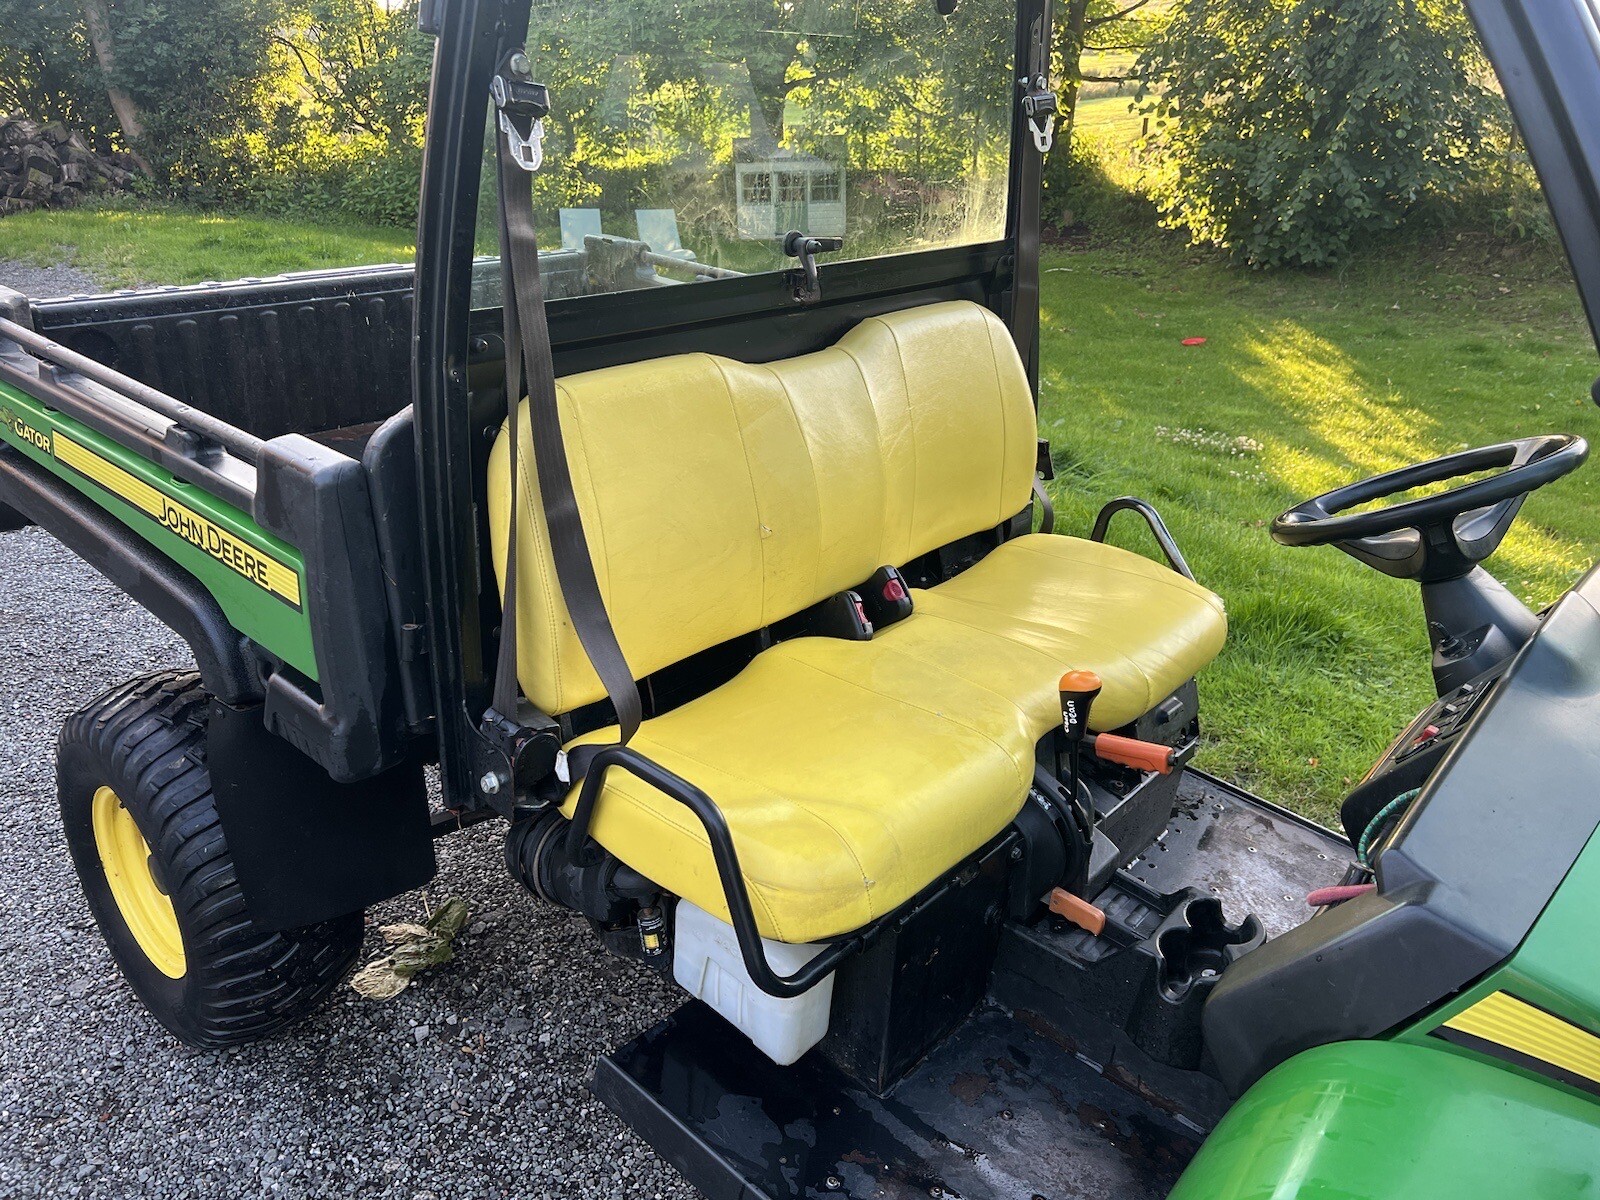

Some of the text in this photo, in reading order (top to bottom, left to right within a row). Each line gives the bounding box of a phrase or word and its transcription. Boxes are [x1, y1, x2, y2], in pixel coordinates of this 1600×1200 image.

[14, 417, 51, 453] GATOR
[159, 498, 269, 587] JOHN DEERE
